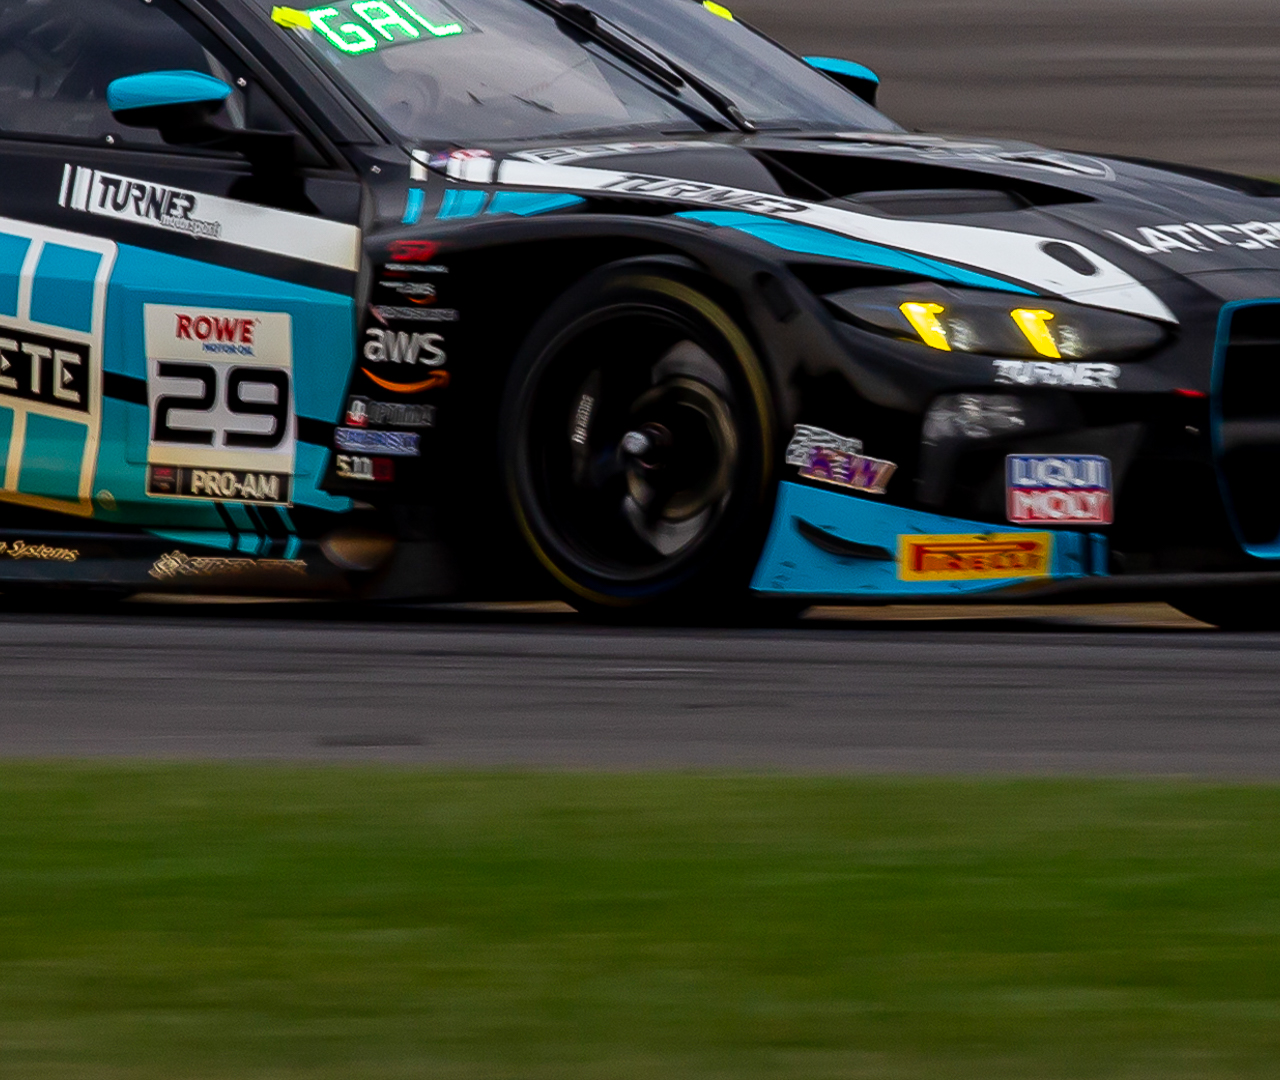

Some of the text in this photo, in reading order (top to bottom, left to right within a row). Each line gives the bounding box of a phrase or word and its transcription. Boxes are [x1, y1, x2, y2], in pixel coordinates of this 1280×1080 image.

[99, 175, 196, 221] TURNER
[175, 313, 257, 344] ROWE
[363, 327, 448, 367] aws
[152, 360, 289, 449] 29
[190, 469, 280, 501] PRO-AM
[6, 539, 80, 563] Systems
